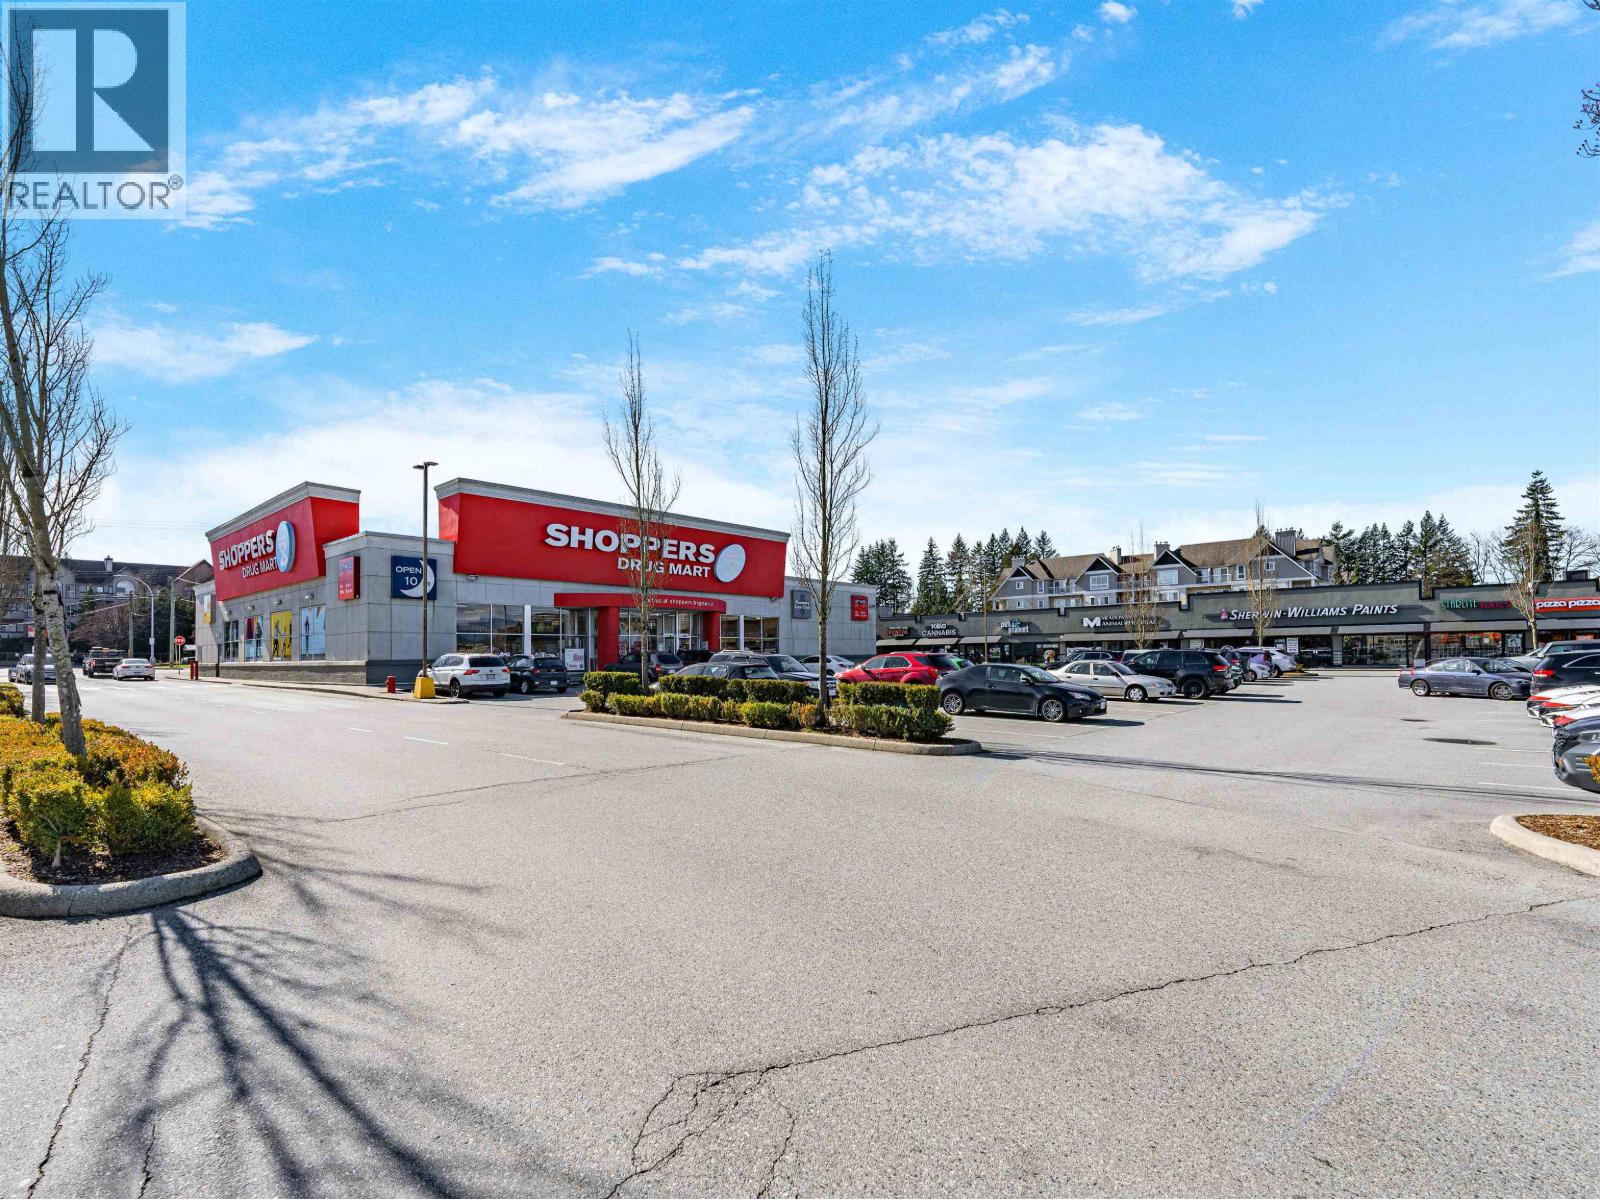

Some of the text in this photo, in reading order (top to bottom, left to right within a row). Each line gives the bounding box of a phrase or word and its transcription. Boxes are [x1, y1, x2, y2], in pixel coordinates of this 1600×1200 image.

[218, 529, 275, 571] SHOPPERS
[544, 522, 716, 565] SHOPPERS
[242, 556, 278, 578] DRUG MART
[395, 565, 422, 574] OPEN
[617, 557, 711, 578] DRUG MART
[405, 576, 418, 586] 10
[1536, 599, 1600, 609] pizza pizza
[921, 629, 957, 637] CANNABIS
